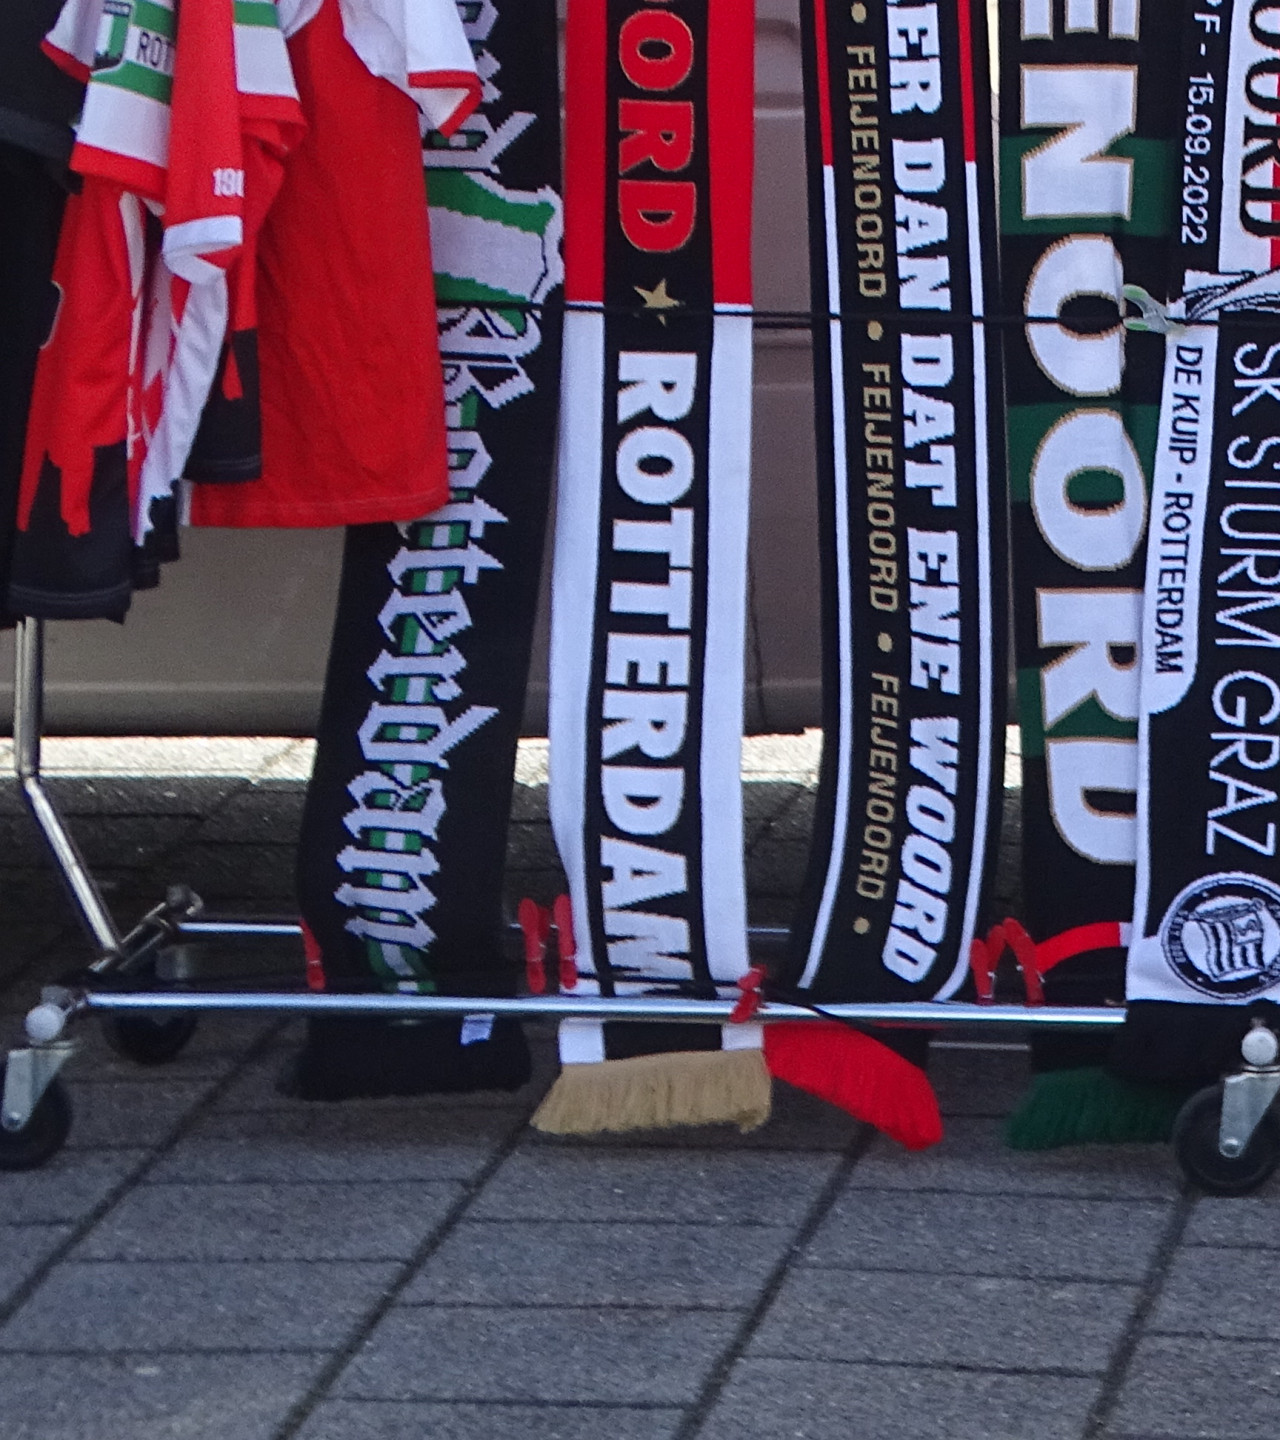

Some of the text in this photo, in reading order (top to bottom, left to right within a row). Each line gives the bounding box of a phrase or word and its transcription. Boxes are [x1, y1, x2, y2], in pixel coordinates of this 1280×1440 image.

[1194, 13, 1220, 37] F
[846, 46, 886, 300] FEIJENOORD
[892, 138, 952, 313] DAN
[1180, 73, 1216, 246] 15.09.2022
[900, 334, 958, 507] DAT
[1168, 388, 1200, 465] KUIP
[1175, 345, 1205, 385] DE
[860, 363, 897, 612] FEIJENOORD
[906, 529, 961, 696] ENE
[1153, 490, 1195, 675] ROTTERDAM
[601, 351, 699, 998] ROTTERDAM
[856, 672, 898, 900] FEIJENOORD
[882, 716, 960, 984] WOORD
